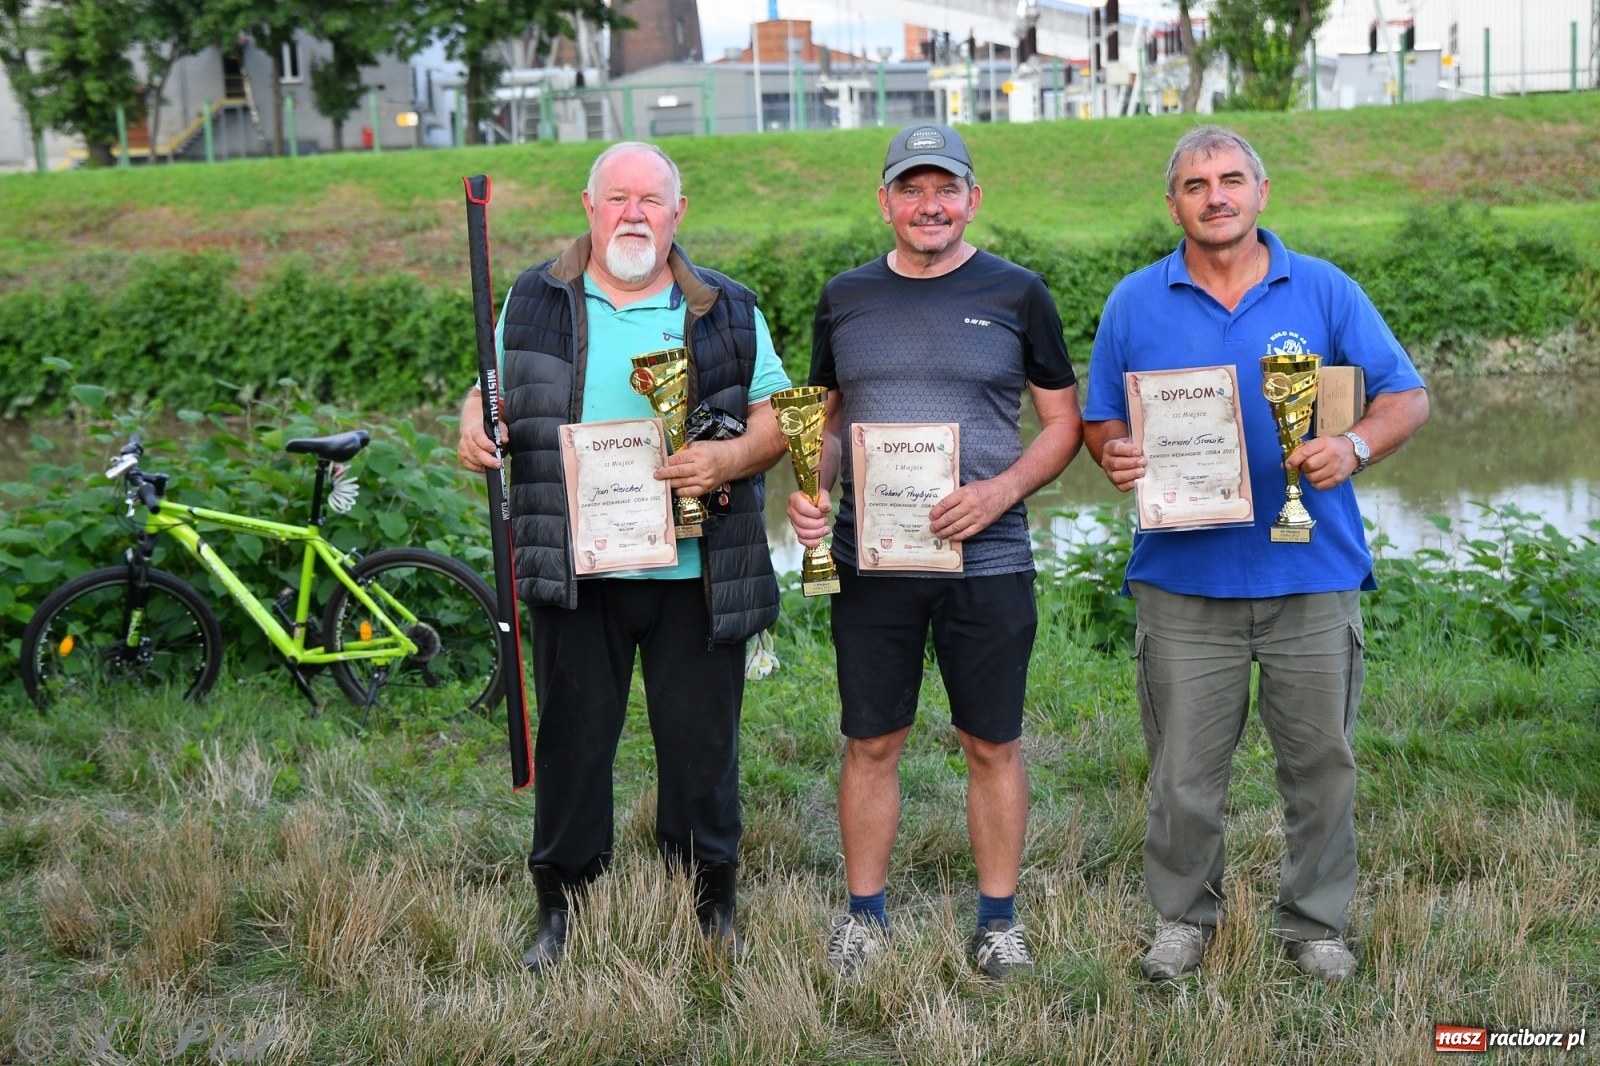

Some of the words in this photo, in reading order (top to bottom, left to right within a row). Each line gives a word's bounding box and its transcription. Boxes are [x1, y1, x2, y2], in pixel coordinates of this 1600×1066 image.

[487, 368, 499, 423] MISTRALL
[1161, 387, 1216, 401] DYPLOM
[1182, 411, 1207, 419] Miejsce
[592, 437, 644, 451] DYPLOM
[1157, 436, 1193, 447] Bernard
[884, 442, 936, 453] DYPLOM
[1171, 451, 1201, 459] WĘDKARSKIE
[611, 460, 635, 468] Miejsce
[899, 464, 923, 472] Miejsce
[588, 487, 609, 502] Jan
[611, 483, 643, 493] Reichel
[874, 484, 903, 497] Roland
[581, 501, 601, 509] ZAWODY
[602, 499, 630, 507] WĘDKARSKIE
